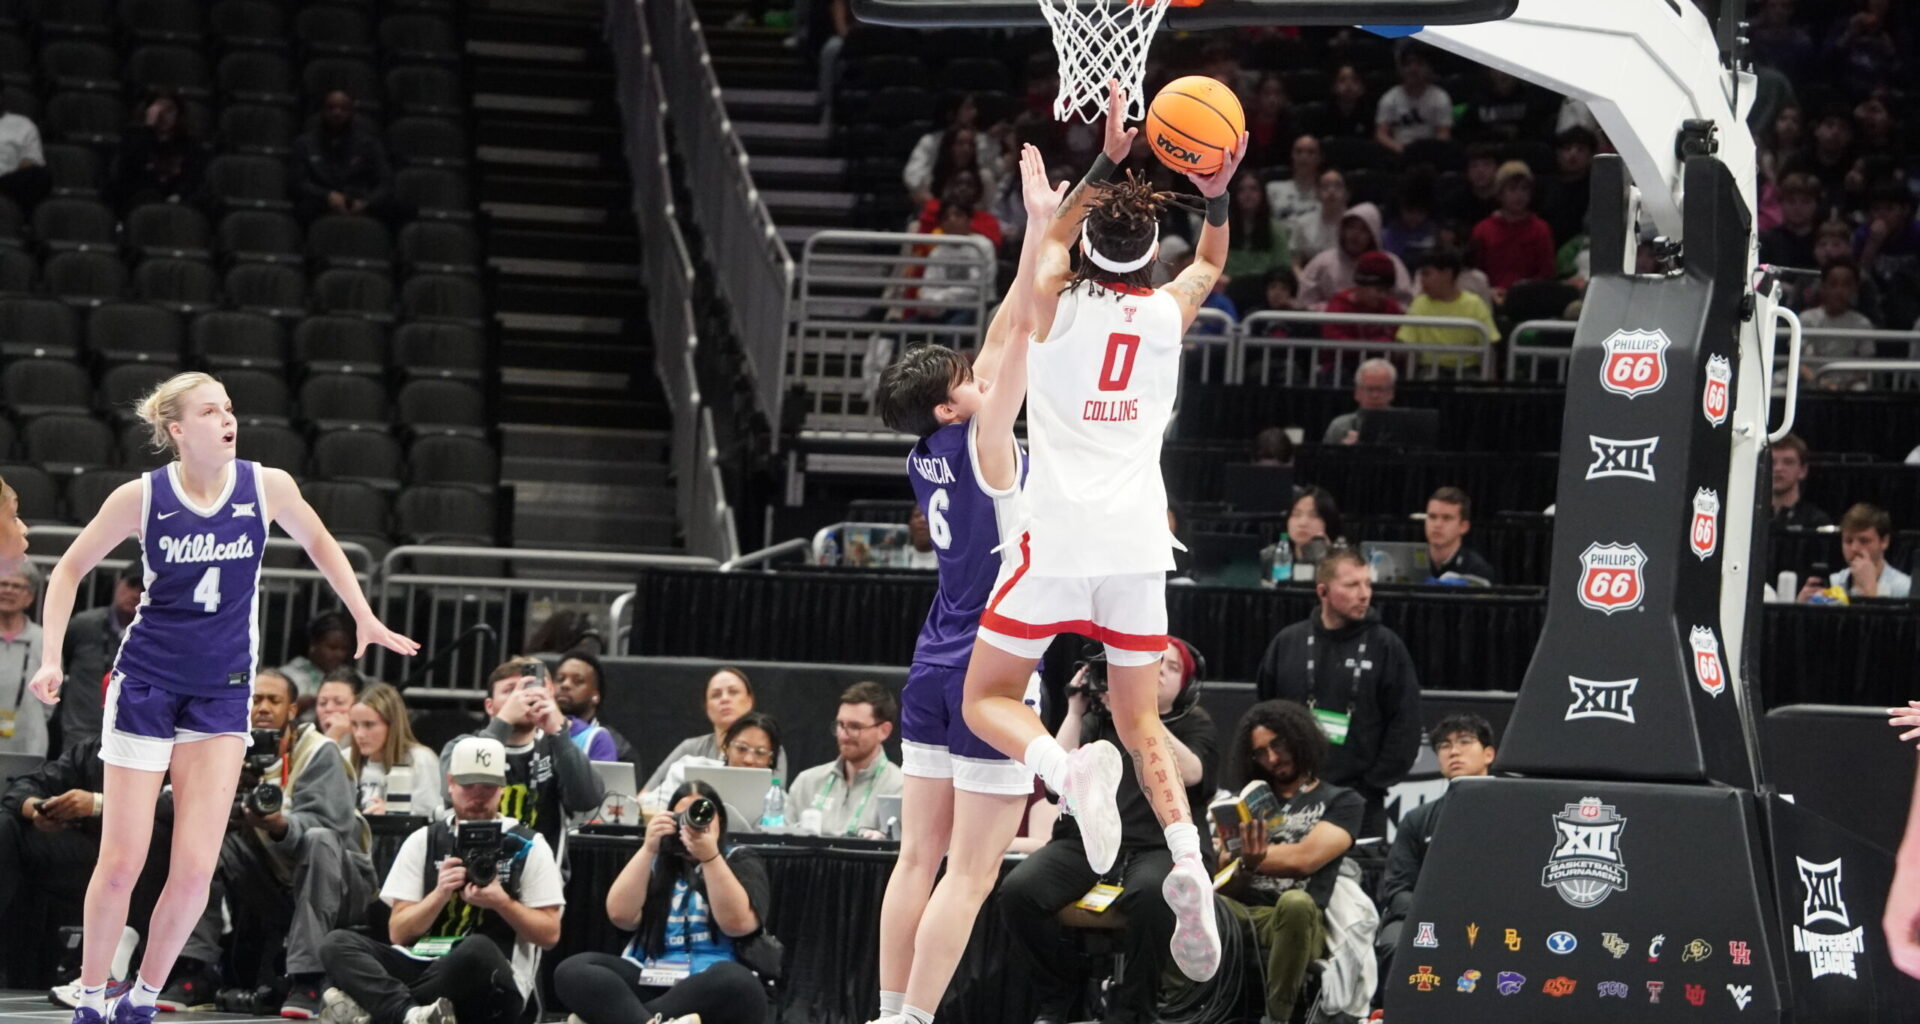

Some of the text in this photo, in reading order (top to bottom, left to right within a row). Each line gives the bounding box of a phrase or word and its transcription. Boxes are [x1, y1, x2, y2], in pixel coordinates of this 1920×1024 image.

[1157, 133, 1202, 165] NCAA
[1612, 338, 1661, 350] PHILLIPS
[1098, 332, 1141, 391] 0
[1613, 356, 1654, 382] 66
[1083, 399, 1138, 421] COLLINS
[1708, 384, 1725, 411] 66
[913, 456, 956, 484] GARCIA
[1590, 440, 1654, 478] XII
[928, 487, 952, 550] 6
[1696, 517, 1713, 545] 66
[159, 532, 254, 563] Wildcats
[1590, 553, 1637, 567] PHILLIPS
[193, 566, 221, 613] 4
[1590, 571, 1632, 598] 66
[1700, 655, 1718, 681] 66
[1567, 680, 1634, 720] XII
[475, 748, 492, 768] KC
[1582, 806, 1598, 817] 66
[1555, 821, 1620, 860] XII
[1547, 868, 1622, 885] TOURNAMENT
[1550, 861, 1620, 877] BASKETBALL
[1800, 863, 1846, 920] XII
[1413, 922, 1439, 948] A
[1504, 928, 1522, 951] BU
[1601, 932, 1629, 959] UCF
[1793, 924, 1864, 953] A DIFFERENT
[1809, 951, 1857, 980] LEAGUE
[1409, 973, 1441, 987] STATE
[1597, 981, 1628, 998] TCU
